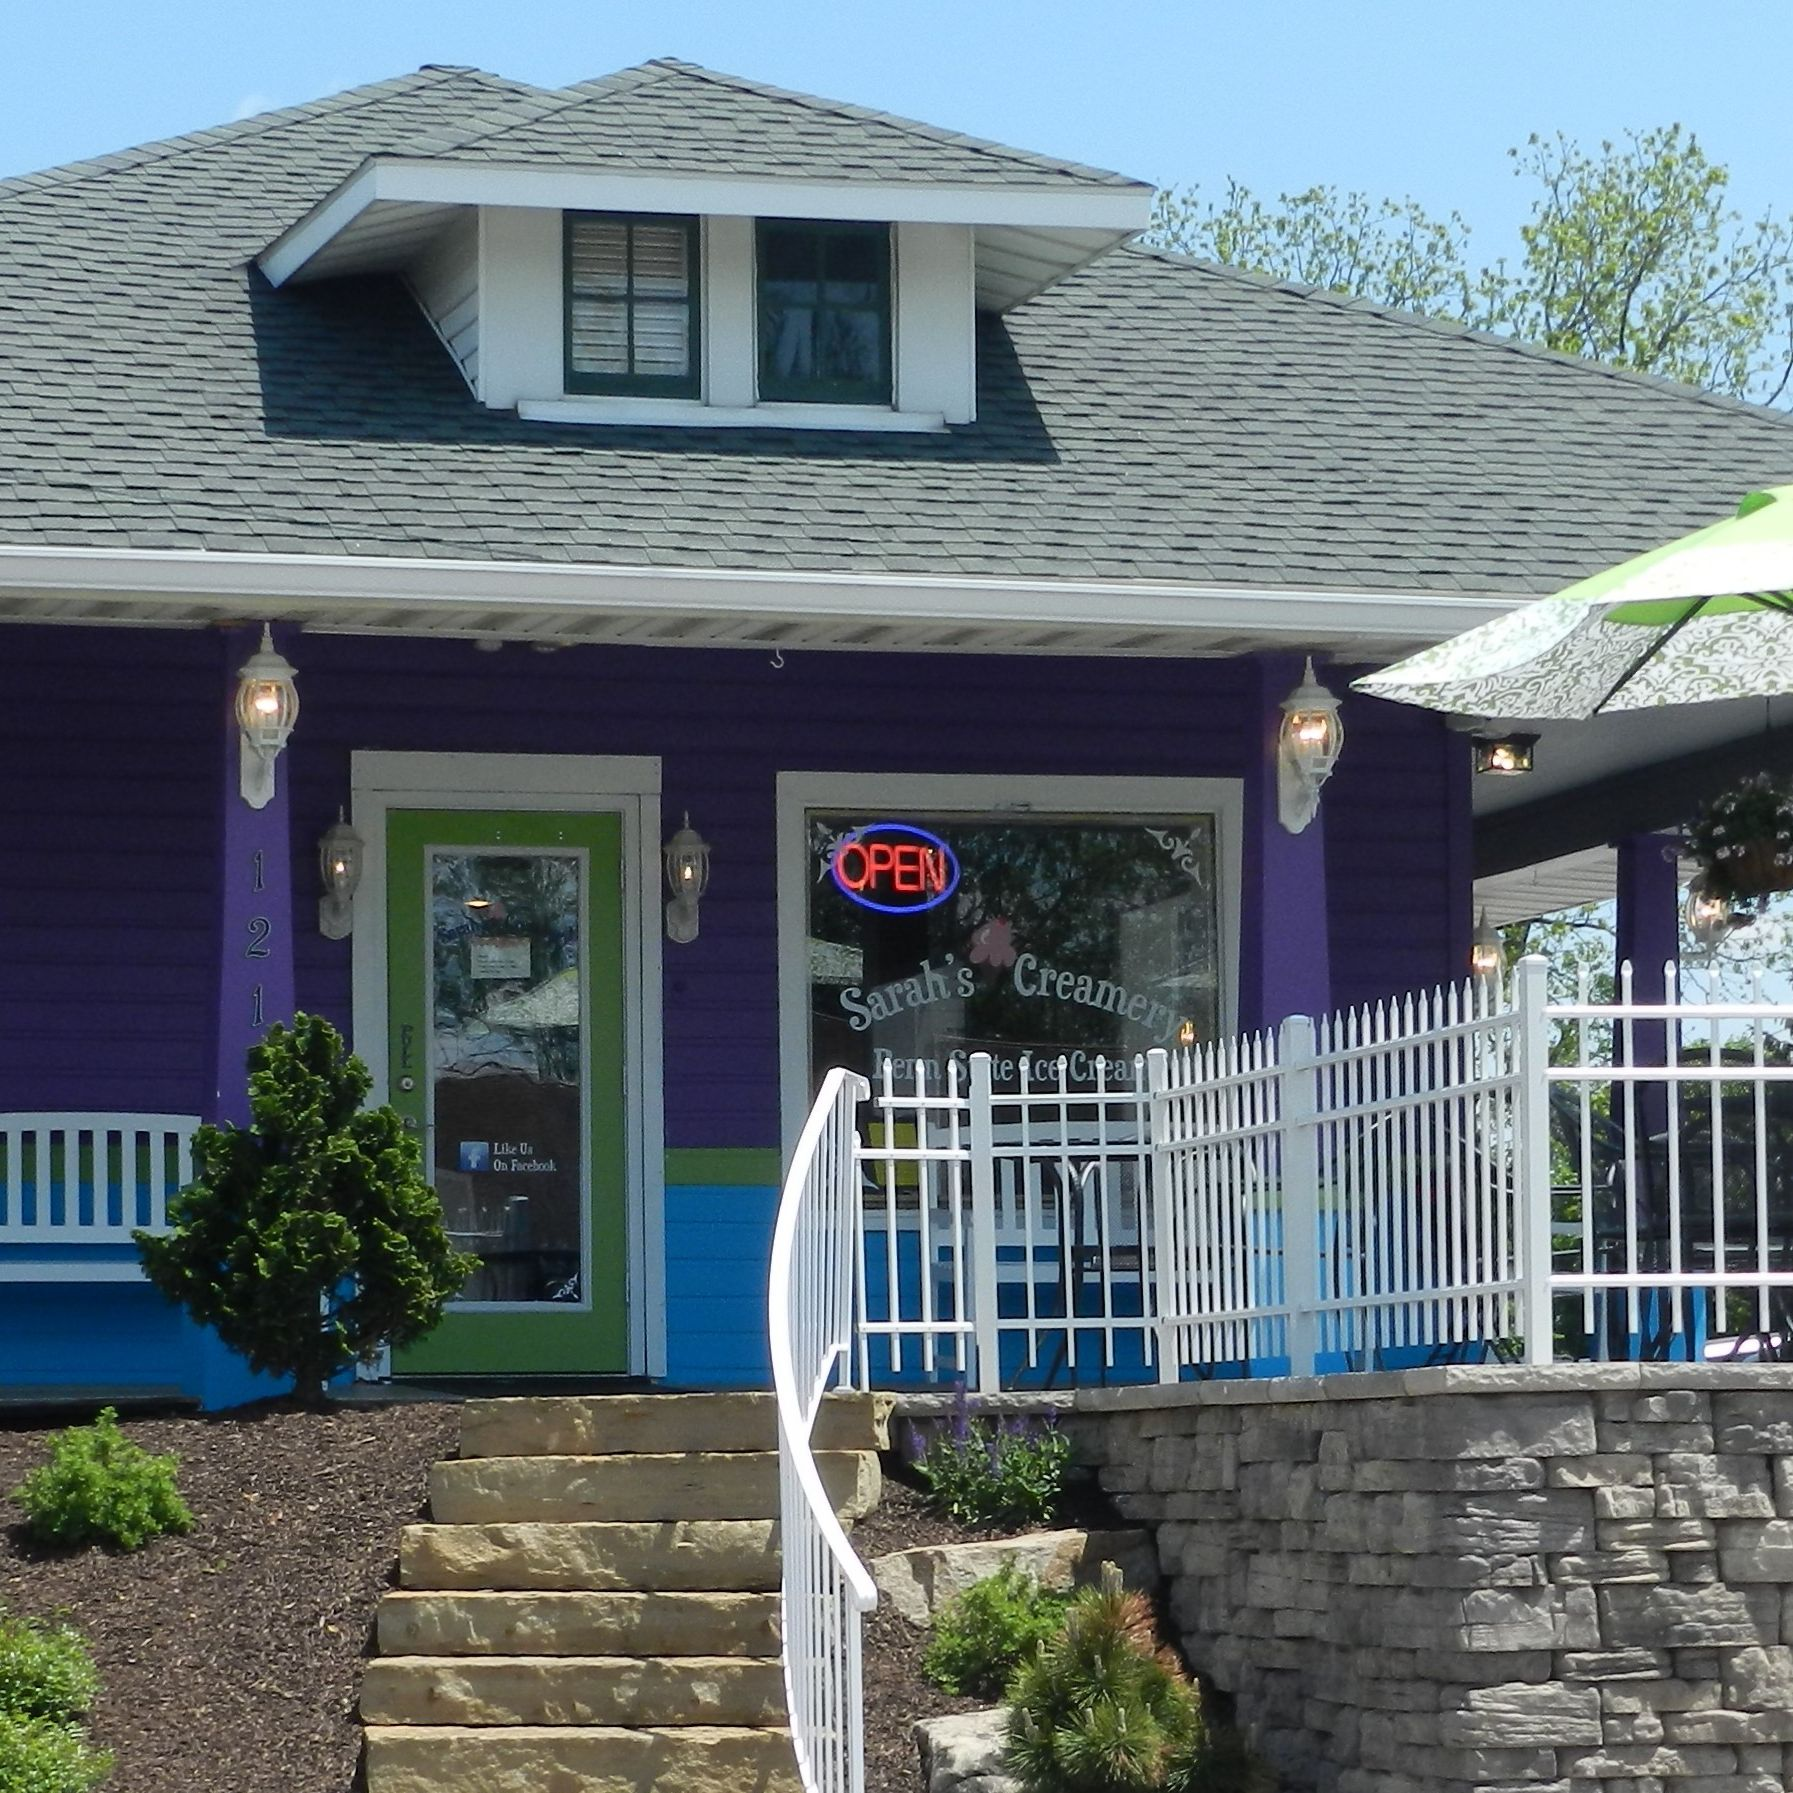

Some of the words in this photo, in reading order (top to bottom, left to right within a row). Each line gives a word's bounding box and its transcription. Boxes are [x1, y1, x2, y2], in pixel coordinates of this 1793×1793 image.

[837, 843, 946, 892] OPEN
[839, 953, 975, 1031] Sarah's
[1013, 952, 1188, 1044] Creamery
[948, 1049, 1014, 1082] Ste
[493, 1142, 517, 1155] Like
[520, 1142, 534, 1155] Us
[493, 1159, 508, 1172] On
